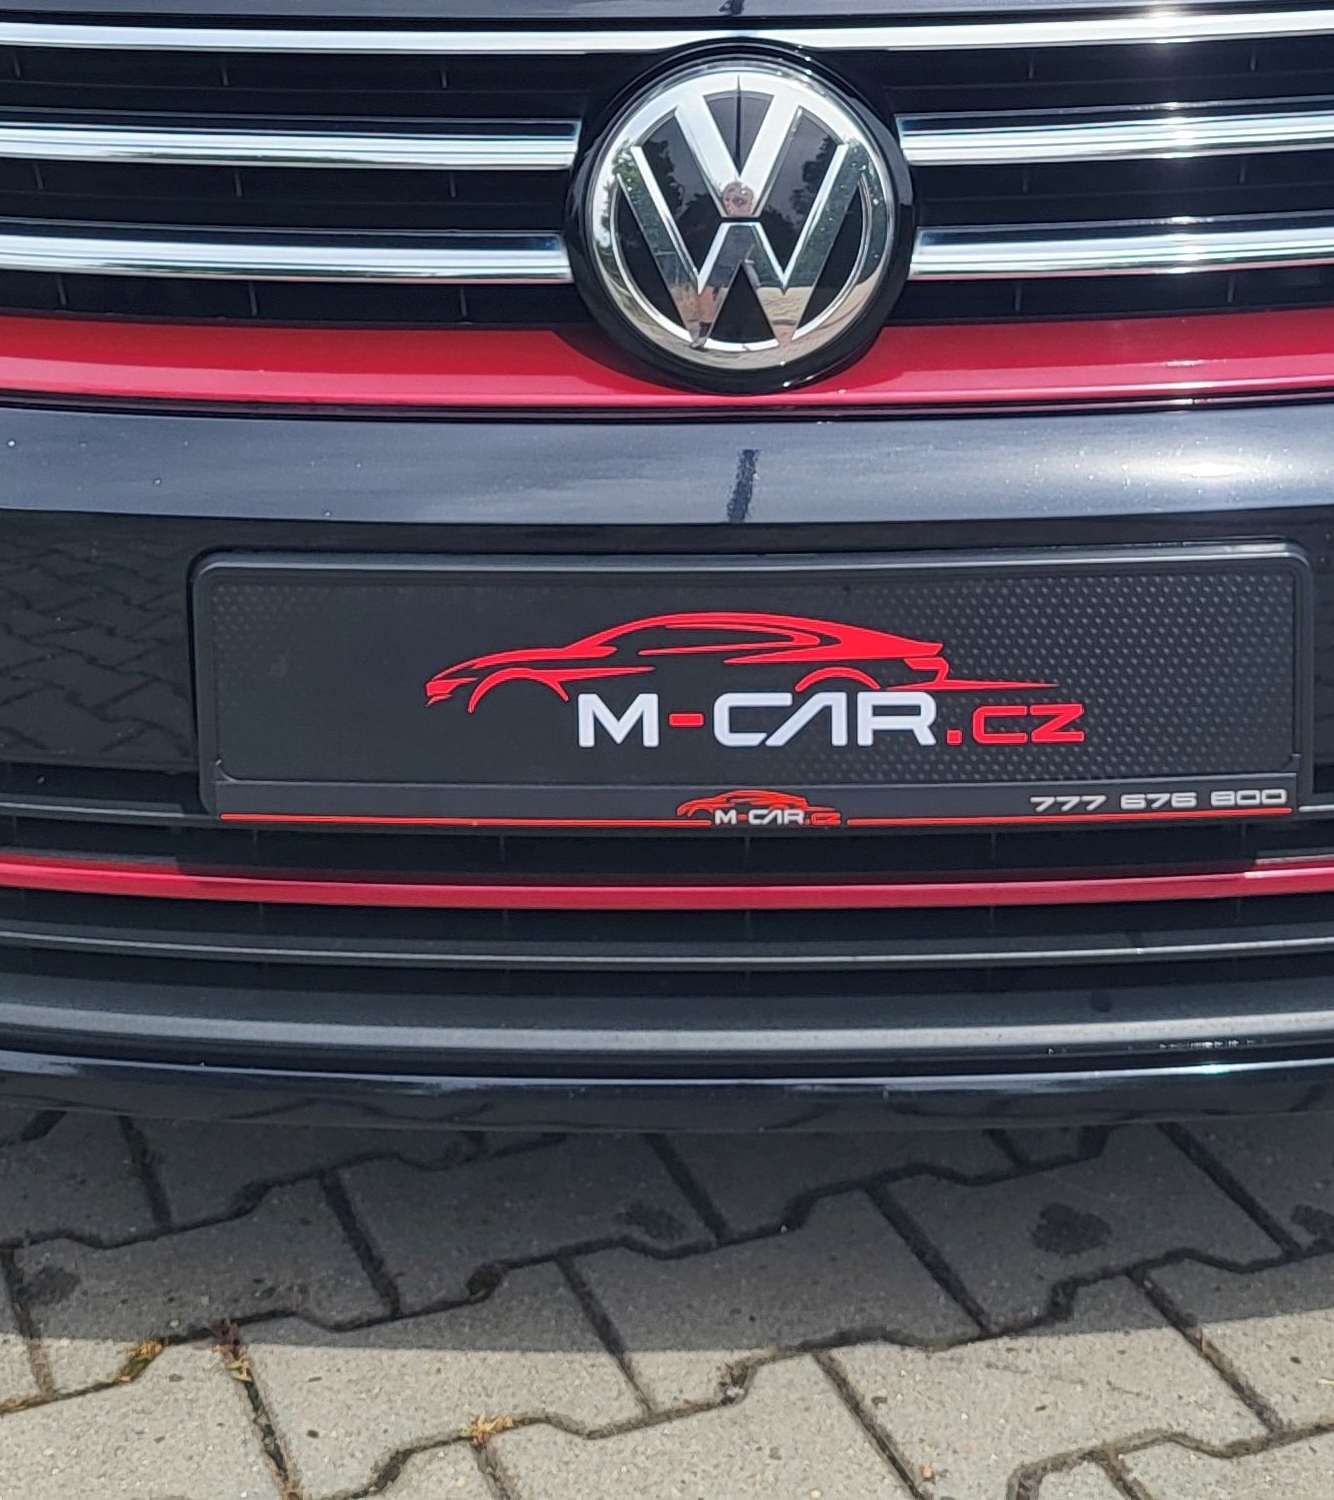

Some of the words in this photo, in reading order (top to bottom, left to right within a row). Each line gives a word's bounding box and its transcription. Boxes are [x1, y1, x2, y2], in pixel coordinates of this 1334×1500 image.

[607, 68, 880, 358] VW
[577, 691, 1086, 748] M-CAR.cz
[1029, 794, 1107, 813] 777
[1120, 791, 1198, 811] 676
[1210, 788, 1288, 807] 800
